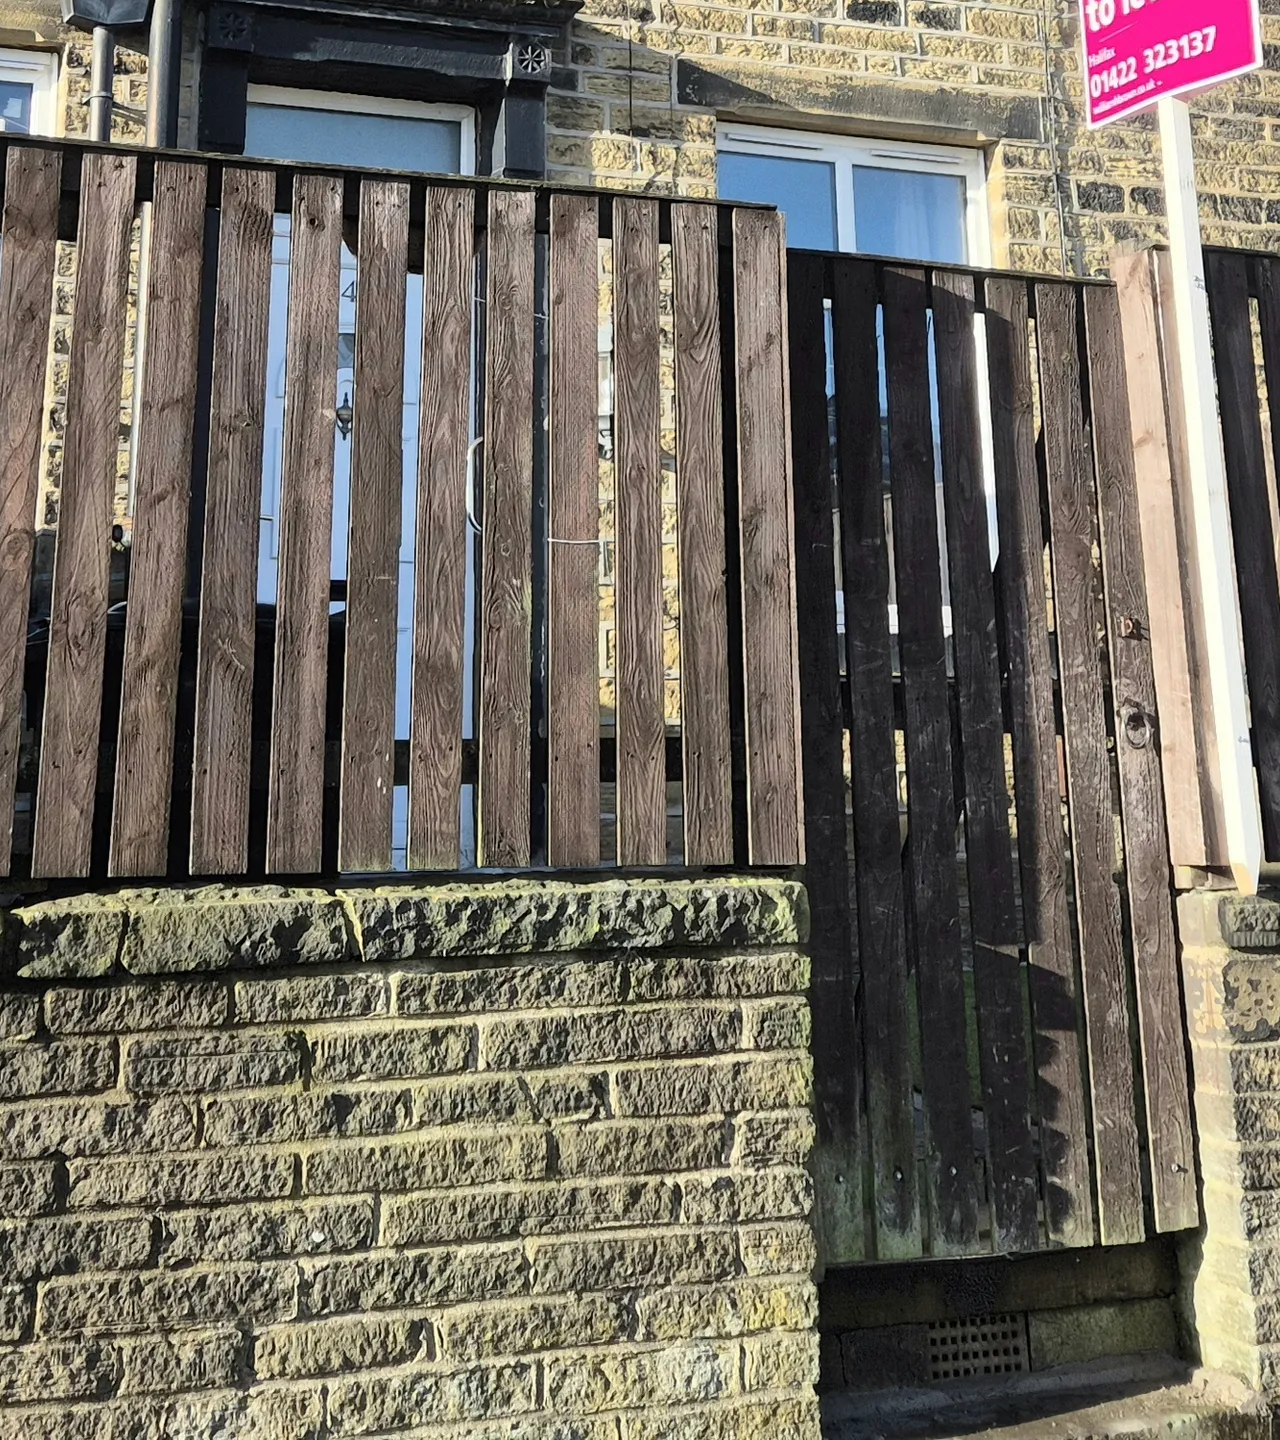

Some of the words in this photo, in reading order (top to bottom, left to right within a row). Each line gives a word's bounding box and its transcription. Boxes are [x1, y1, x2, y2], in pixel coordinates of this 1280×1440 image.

[1090, 56, 1138, 98] 01422
[1142, 25, 1217, 74] 323137
[341, 280, 357, 303] 4
